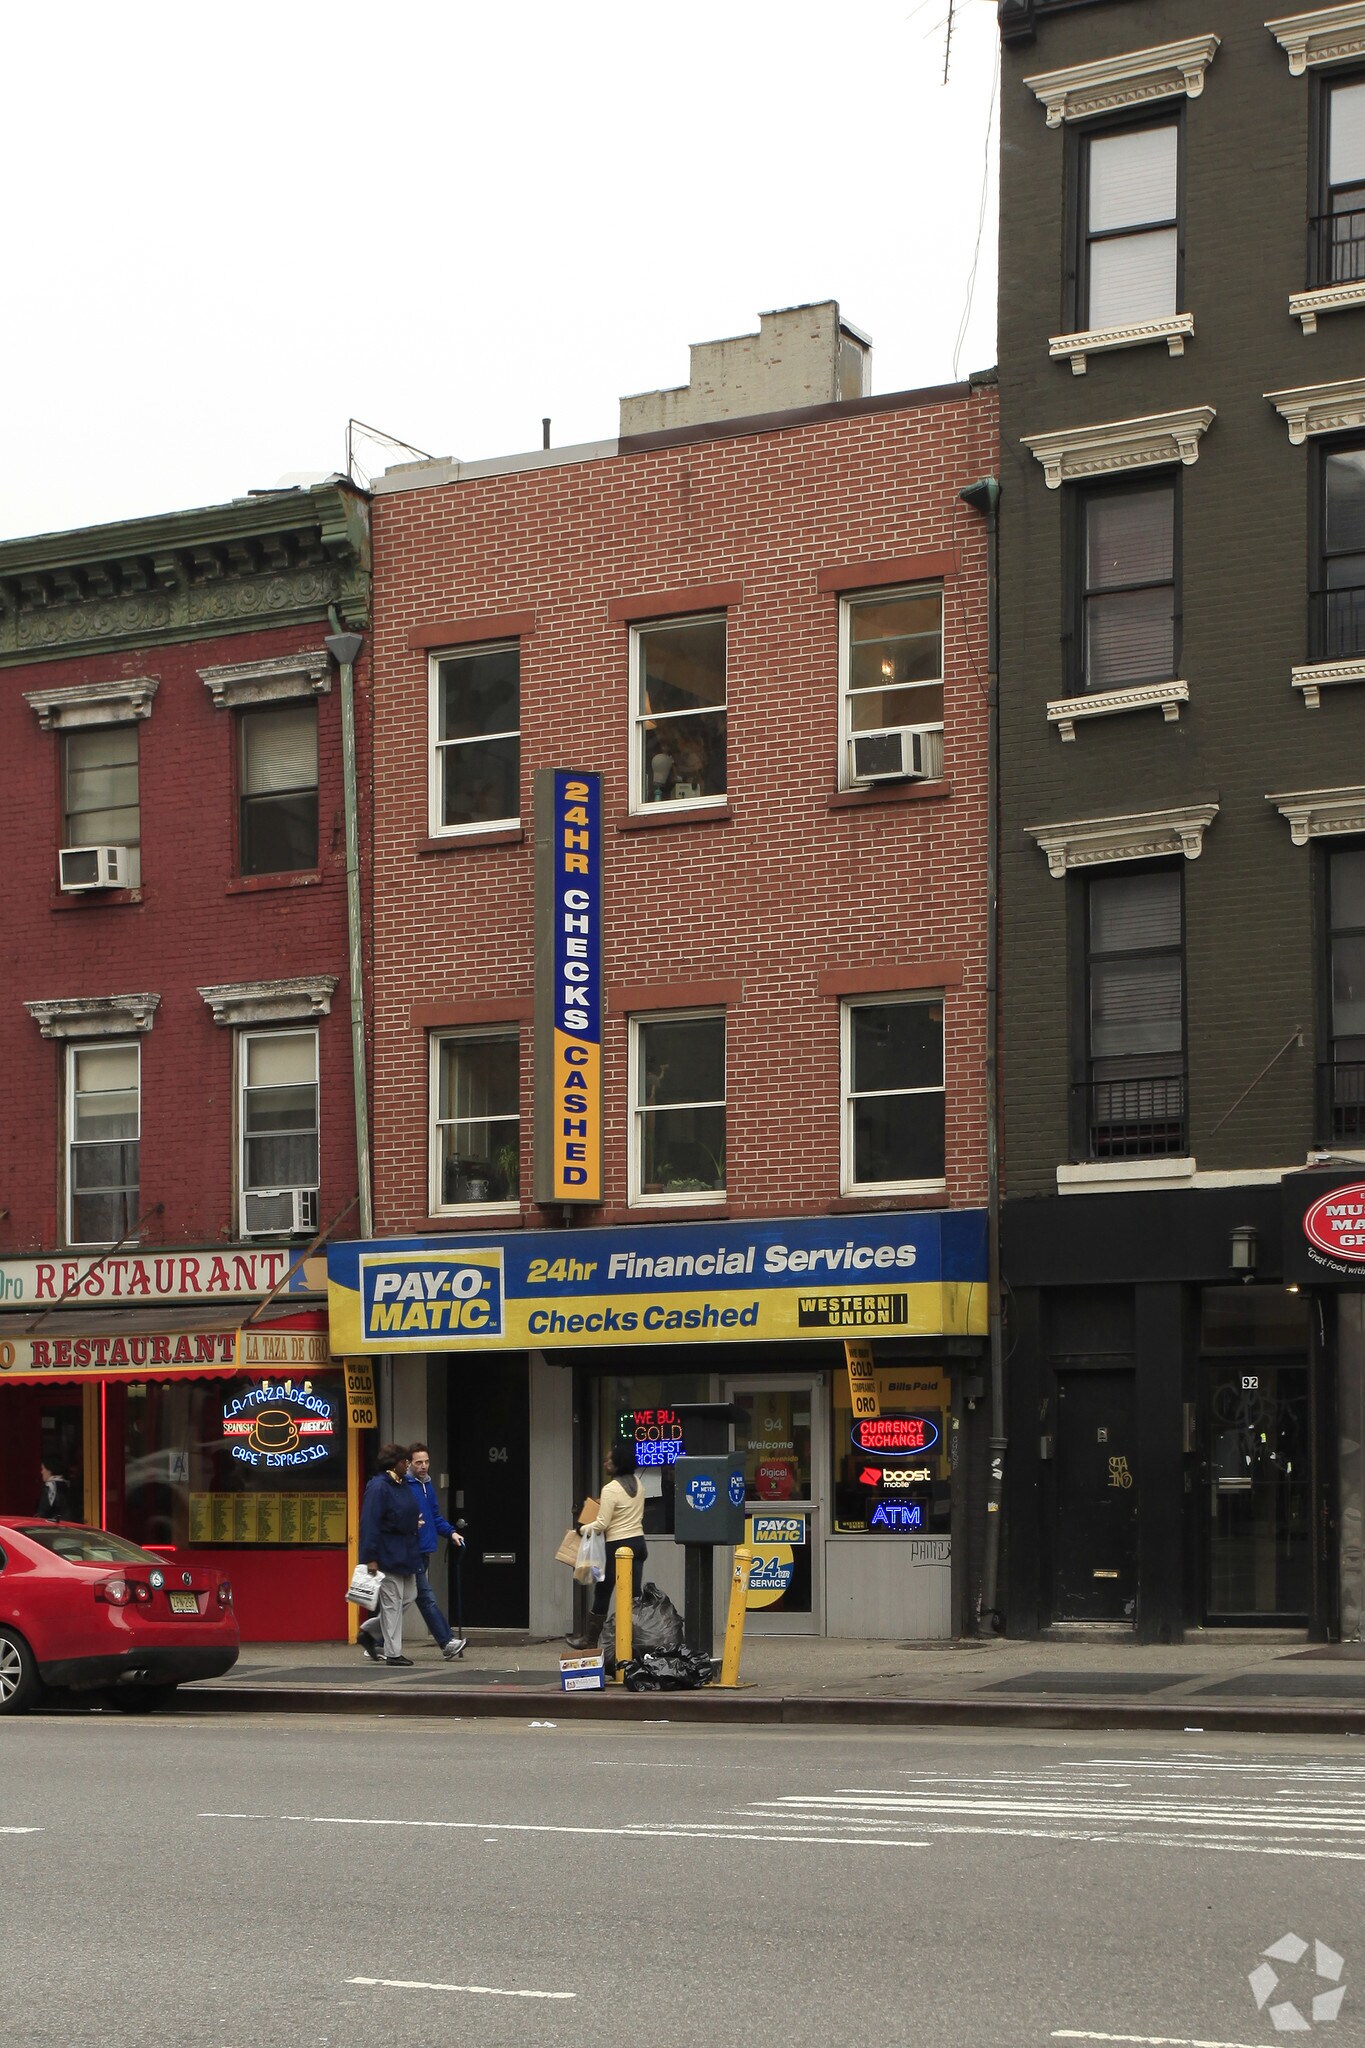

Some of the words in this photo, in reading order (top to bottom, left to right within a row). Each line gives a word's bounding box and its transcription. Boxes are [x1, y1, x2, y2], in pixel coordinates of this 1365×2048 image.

[563, 781, 589, 875] 24HR
[563, 889, 590, 1030] CHECKS
[563, 1046, 589, 1186] CASHED
[1325, 1205, 1365, 1216] MU
[526, 1258, 598, 1283] 24hr
[607, 1246, 756, 1279] Financial
[764, 1242, 917, 1273] Services
[1327, 1260, 1348, 1273] Food
[34, 1253, 284, 1299] RESTAURANT
[800, 1296, 889, 1312] WESTERN
[369, 1299, 491, 1332] MATIC
[528, 1307, 639, 1335] Checks
[643, 1302, 759, 1331] Cashed
[828, 1310, 889, 1325] UNION
[30, 1334, 236, 1368] RESTAURANT
[246, 1337, 259, 1361] LA
[263, 1337, 287, 1361] TAZA
[291, 1337, 304, 1361] DE
[309, 1337, 328, 1361] ORO
[850, 1361, 873, 1376] GOLD
[348, 1376, 372, 1390] GOLD
[888, 1382, 911, 1391] Bills
[913, 1381, 938, 1391] Paid
[1243, 1377, 1258, 1388] 92
[245, 1386, 286, 1407] TAZA
[305, 1396, 331, 1419] ORO
[856, 1397, 876, 1412] ORO
[352, 1409, 373, 1423] ORO
[633, 1410, 655, 1424] WE
[657, 1410, 681, 1424] BU
[764, 1418, 784, 1432] 94
[860, 1420, 924, 1434] CURRENCY
[635, 1425, 683, 1441] GOLD
[861, 1434, 924, 1447] EXCHANGE
[636, 1441, 682, 1453] HIGHEST
[747, 1440, 794, 1450] Welcome
[266, 1445, 329, 1466] ESPRESSO
[489, 1447, 508, 1462] 94
[635, 1453, 664, 1465] RICES
[173, 1456, 186, 1473] A
[760, 1468, 787, 1478] Digicel
[882, 1468, 931, 1481] boost
[691, 1481, 699, 1492] P
[872, 1506, 920, 1523] ATM
[756, 1530, 800, 1541] MATIC
[749, 1556, 779, 1577] 24
[750, 1579, 787, 1587] SERVICE
